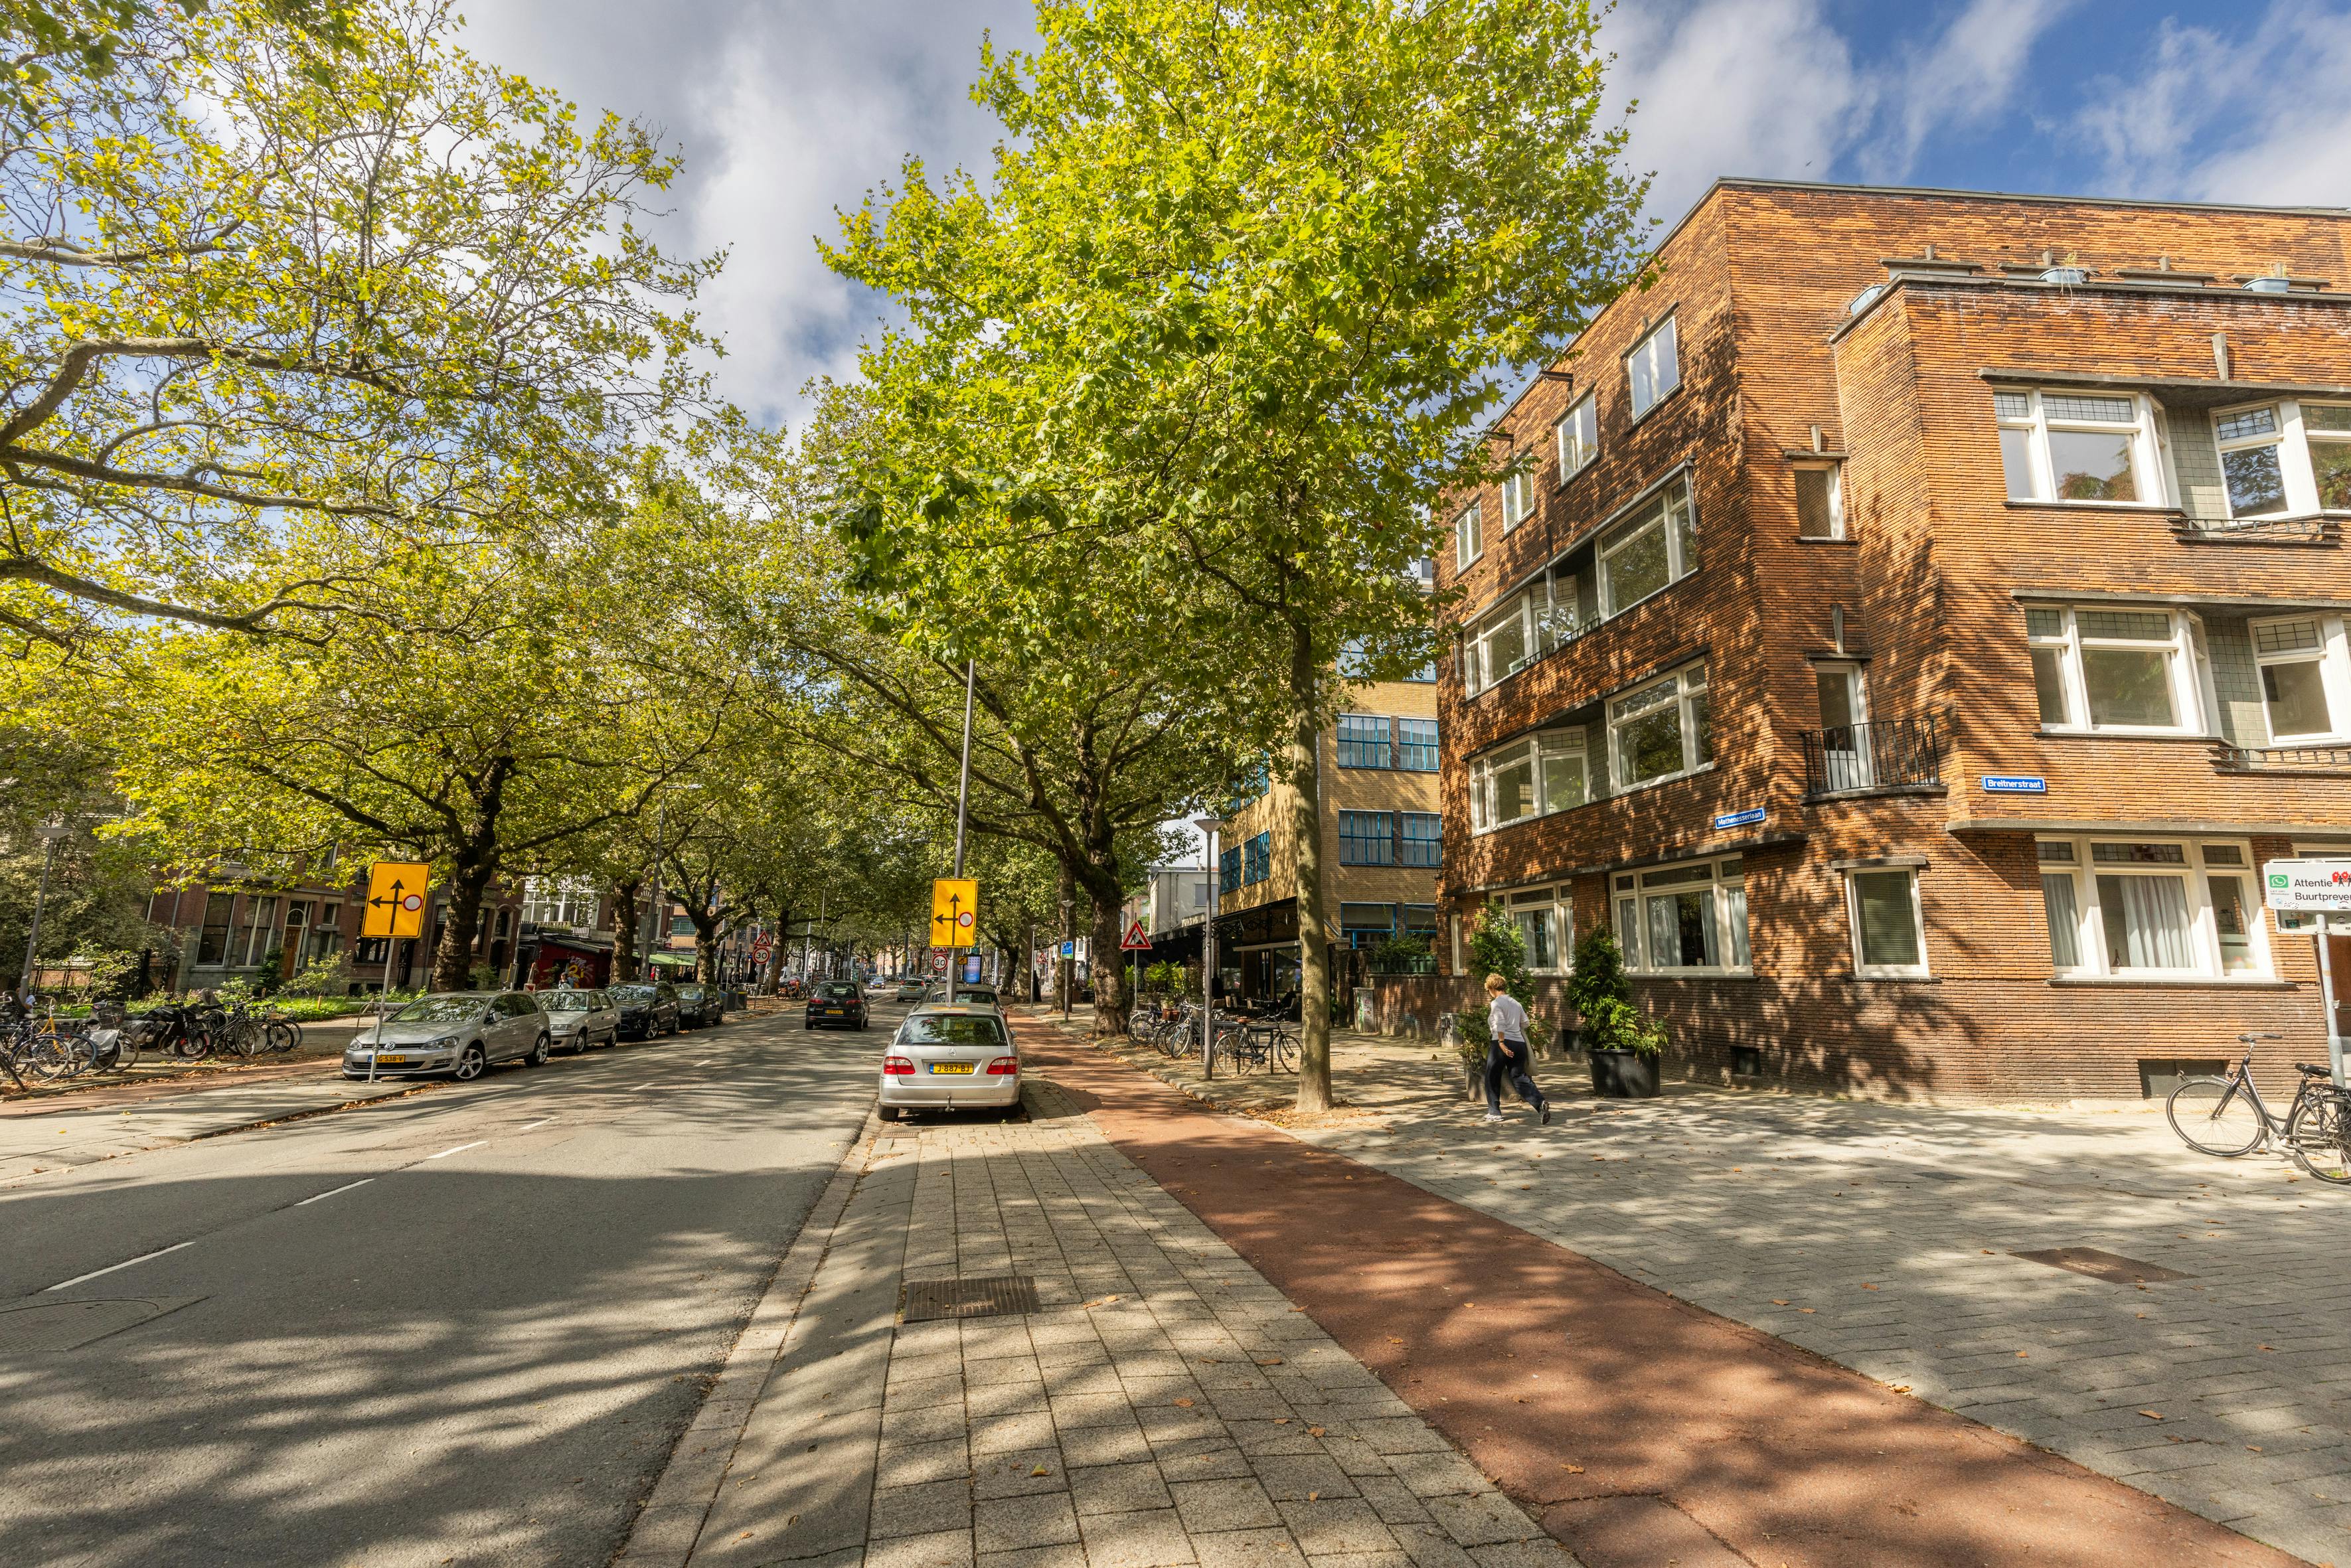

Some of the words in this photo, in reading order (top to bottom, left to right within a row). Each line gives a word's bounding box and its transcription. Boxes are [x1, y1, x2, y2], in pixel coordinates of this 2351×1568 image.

[1987, 779, 2042, 789] Breitnerstraat
[1718, 812, 1761, 826] Mathenesserlaan
[2295, 892, 2351, 902] Buurtpreve
